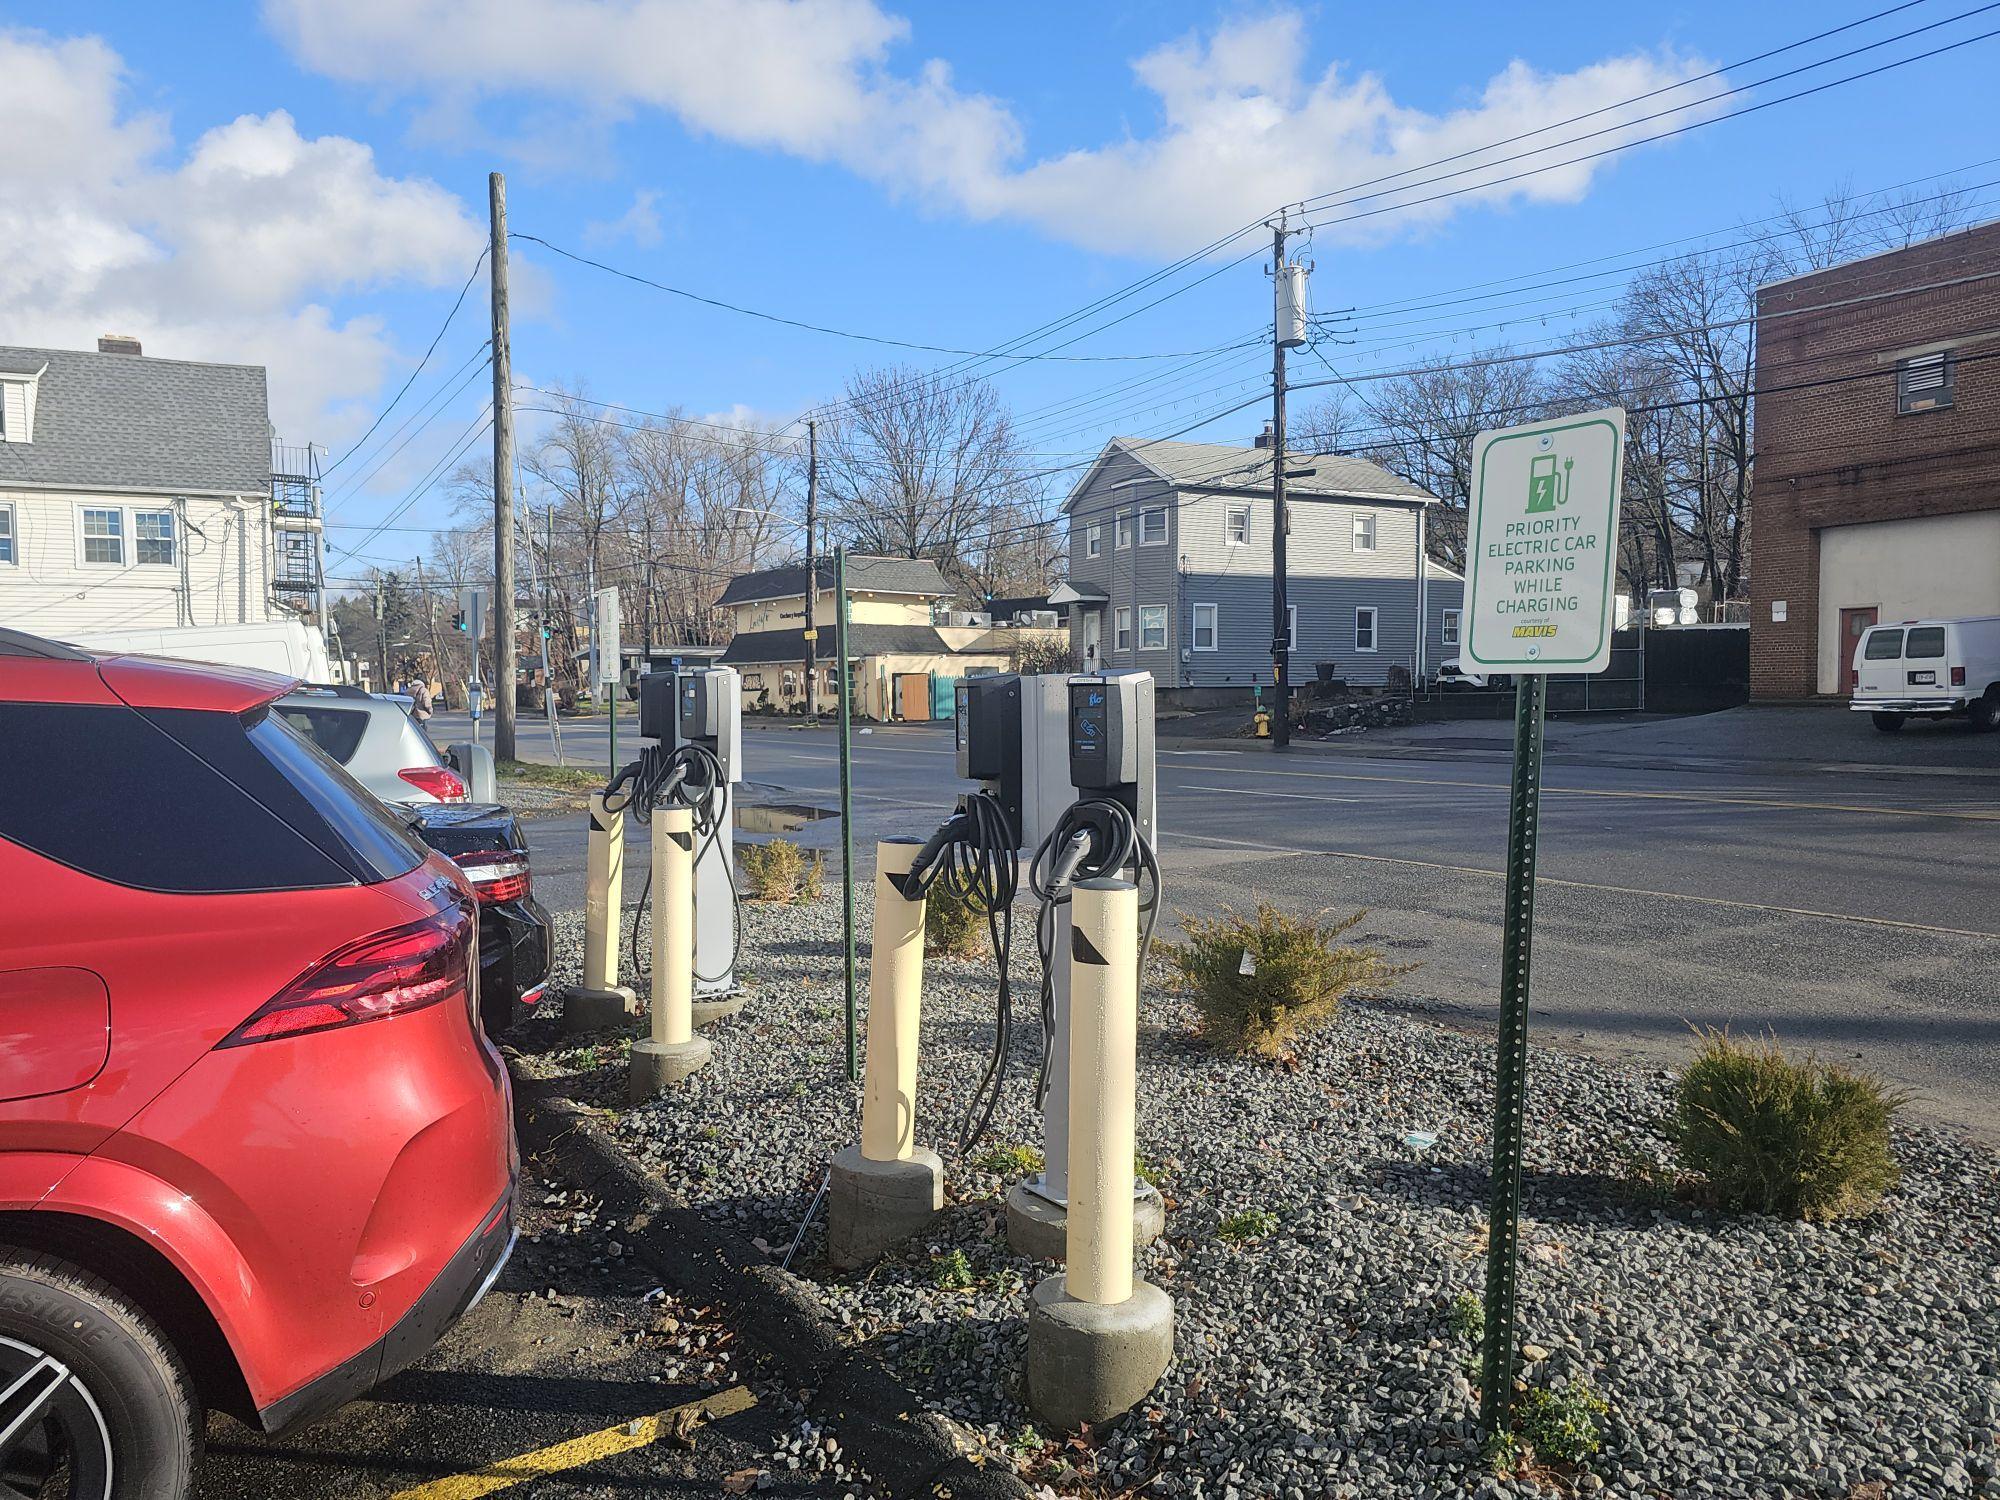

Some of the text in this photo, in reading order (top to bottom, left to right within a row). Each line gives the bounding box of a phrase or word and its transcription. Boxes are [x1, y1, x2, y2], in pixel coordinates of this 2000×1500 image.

[1505, 515, 1581, 538] PRIORITY
[1488, 534, 1596, 558] ELECTRIC CAR
[1504, 556, 1575, 576] PARKING
[1514, 577, 1563, 594] WHILE
[1496, 596, 1579, 614] CHARGING
[1512, 625, 1558, 638] MAVIS
[1088, 692, 1104, 707] flo
